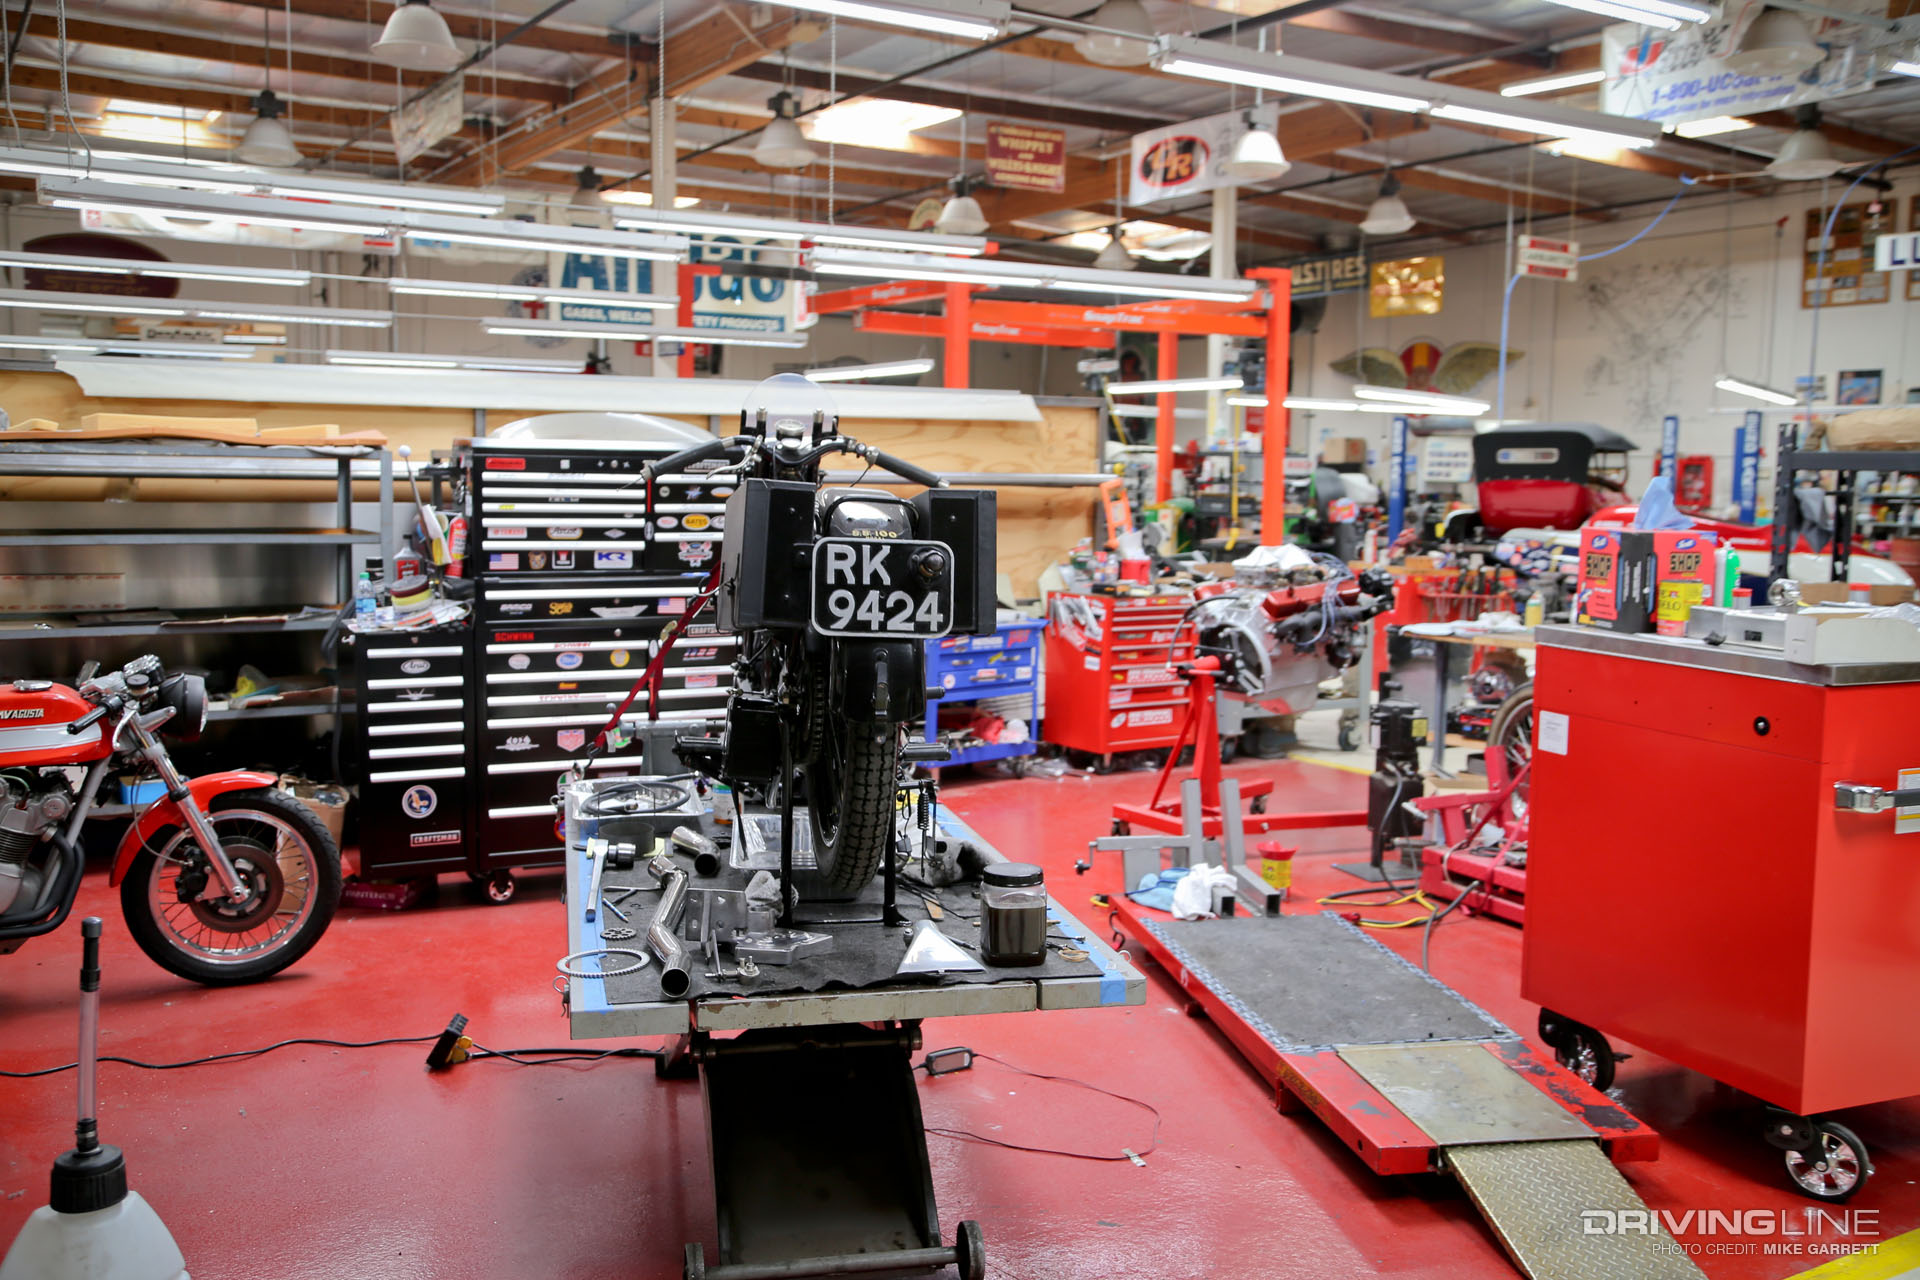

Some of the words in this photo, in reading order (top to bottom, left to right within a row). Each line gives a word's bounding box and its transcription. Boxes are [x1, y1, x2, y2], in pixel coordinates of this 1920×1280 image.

[608, 309, 652, 323] WELDIN
[827, 544, 891, 585] RK
[1586, 552, 1612, 578] SHOP
[1669, 552, 1702, 574] SHOP
[828, 589, 944, 632] 9424
[414, 833, 458, 844] CRAFTSMAN
